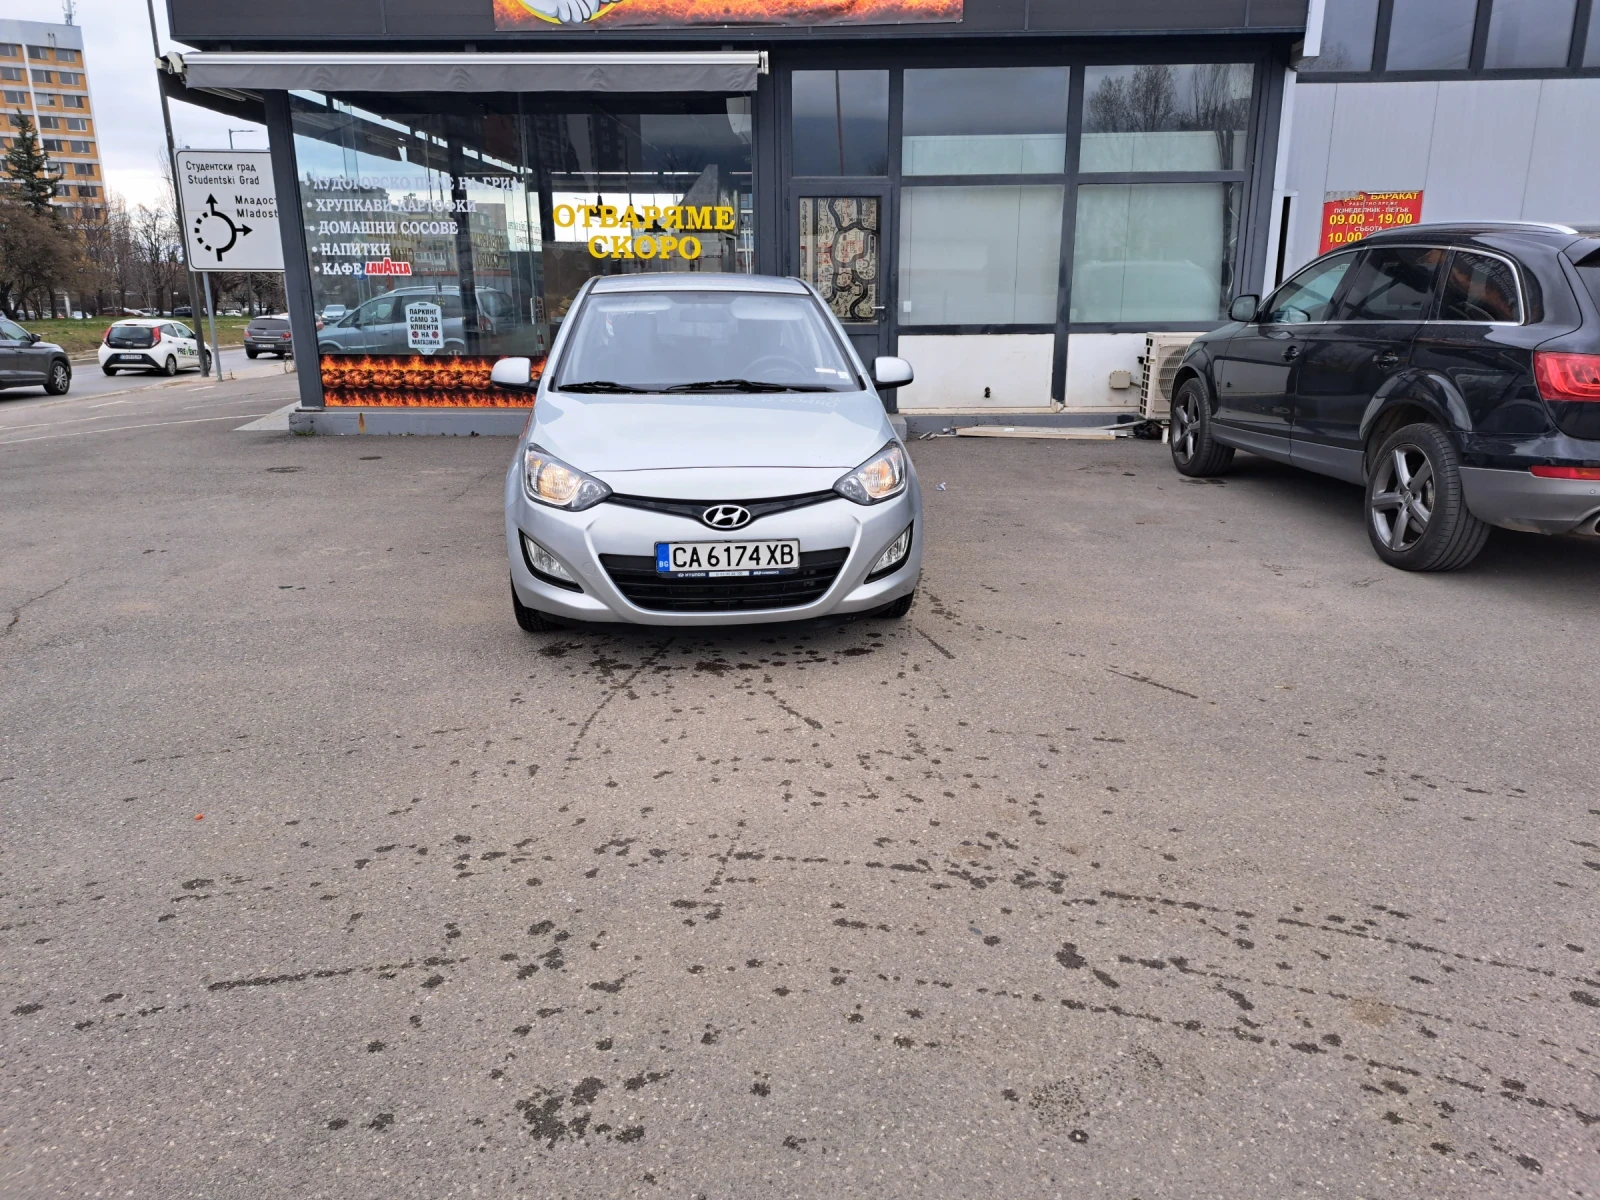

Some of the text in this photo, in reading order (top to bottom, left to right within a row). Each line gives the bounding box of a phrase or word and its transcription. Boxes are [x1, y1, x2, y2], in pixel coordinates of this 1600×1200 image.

[185, 160, 256, 173] Студентски град
[187, 174, 260, 185] Studentski Grad
[458, 176, 479, 190] НА
[234, 195, 277, 206] Младос
[315, 198, 477, 213] ХРУПКАВИ КАРТОФКИ
[236, 208, 278, 218] Mladost
[553, 204, 736, 230] ОТВАРЯМЕ
[1329, 213, 1365, 225] 09.00
[1378, 213, 1413, 224] 19.00
[318, 221, 458, 236] ДОМАШНИ СОСОВЕ
[1327, 232, 1363, 243] 10.00
[320, 243, 391, 256] НАПИТКИ
[587, 235, 703, 260] СКОРО
[321, 262, 363, 275] КАФЕ
[365, 258, 412, 275] LAVAZZA
